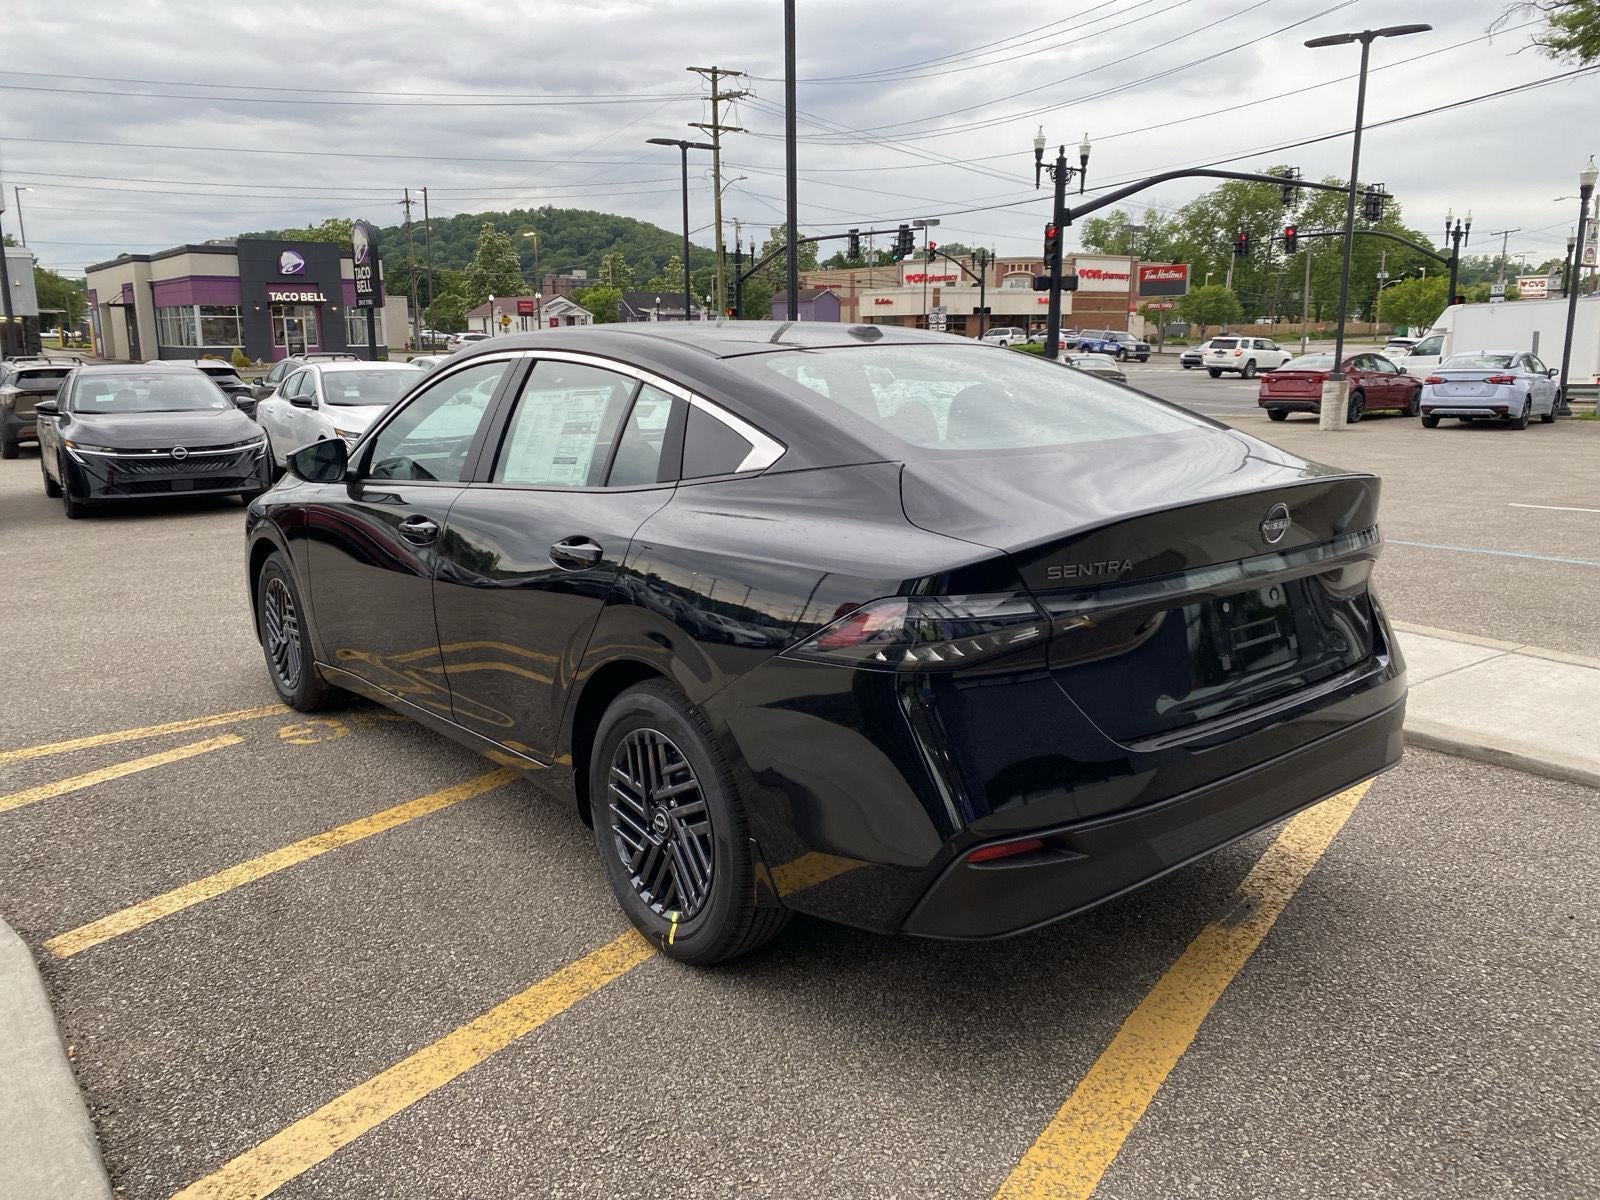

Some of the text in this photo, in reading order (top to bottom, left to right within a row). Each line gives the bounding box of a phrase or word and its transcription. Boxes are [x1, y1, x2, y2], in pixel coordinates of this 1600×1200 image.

[355, 266, 370, 279] TACO
[1086, 269, 1130, 281] CVS pharmacy
[1144, 269, 1157, 280] Tim
[912, 273, 958, 284] CVS pharmacy
[1528, 280, 1545, 288] CVS
[357, 280, 372, 293] BELL
[269, 292, 327, 302] TACO BELL
[1047, 559, 1133, 579] SENTRA
